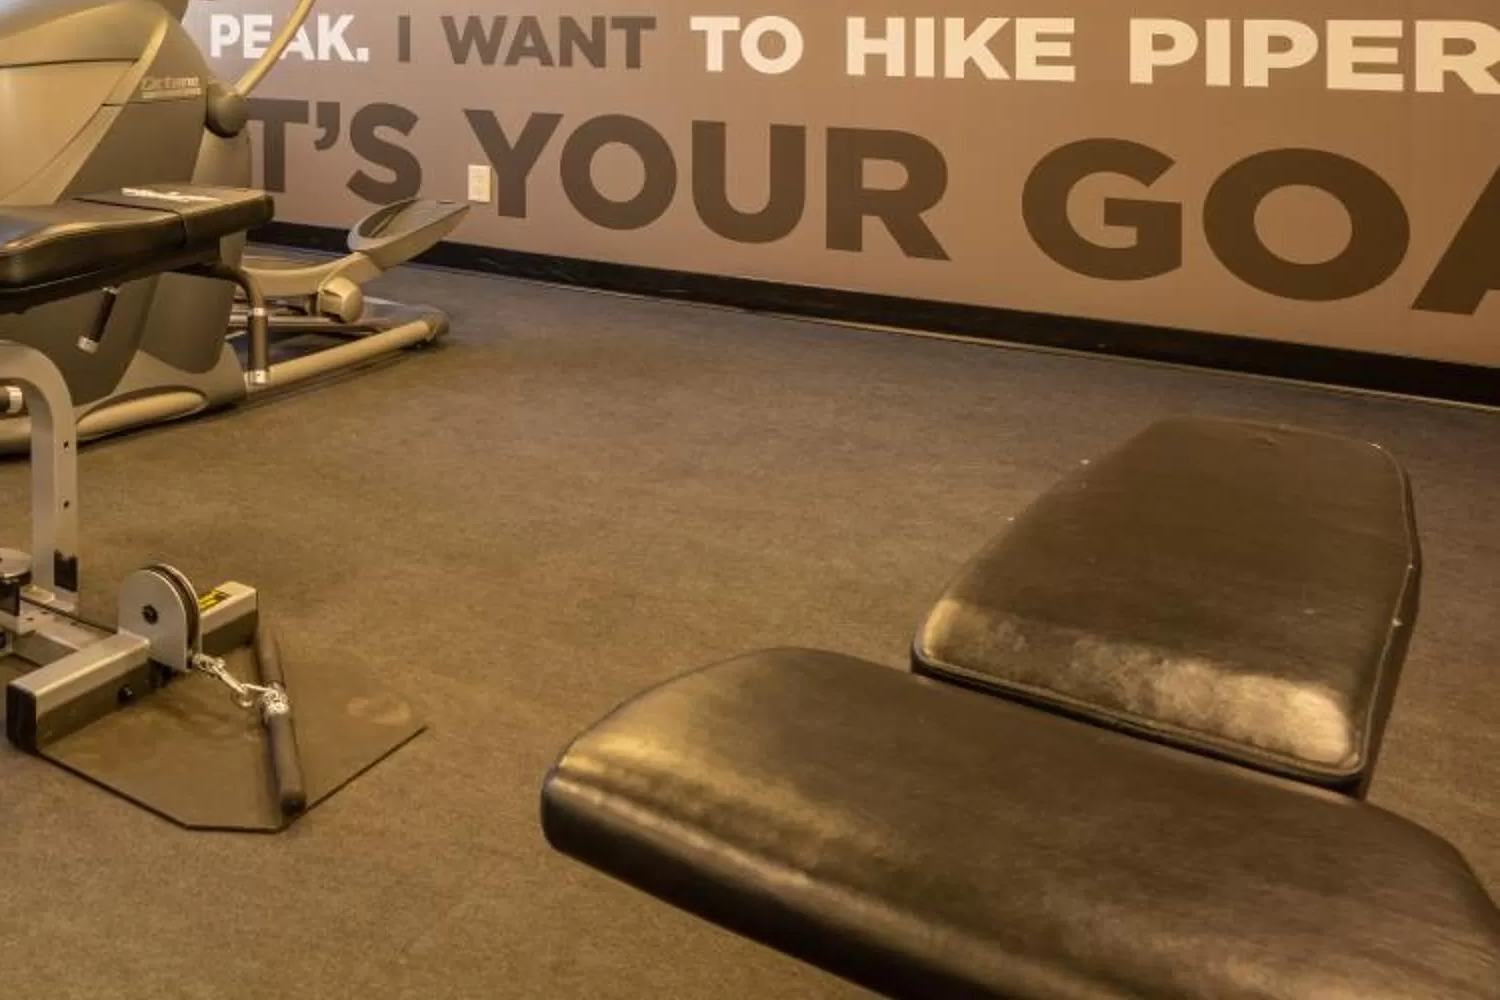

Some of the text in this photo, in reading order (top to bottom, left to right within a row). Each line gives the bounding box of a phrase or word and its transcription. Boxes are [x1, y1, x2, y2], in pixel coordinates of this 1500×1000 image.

[210, 13, 1500, 95] PEAK. I WANT TO HIKE PIPER
[462, 108, 953, 263] YOUR
